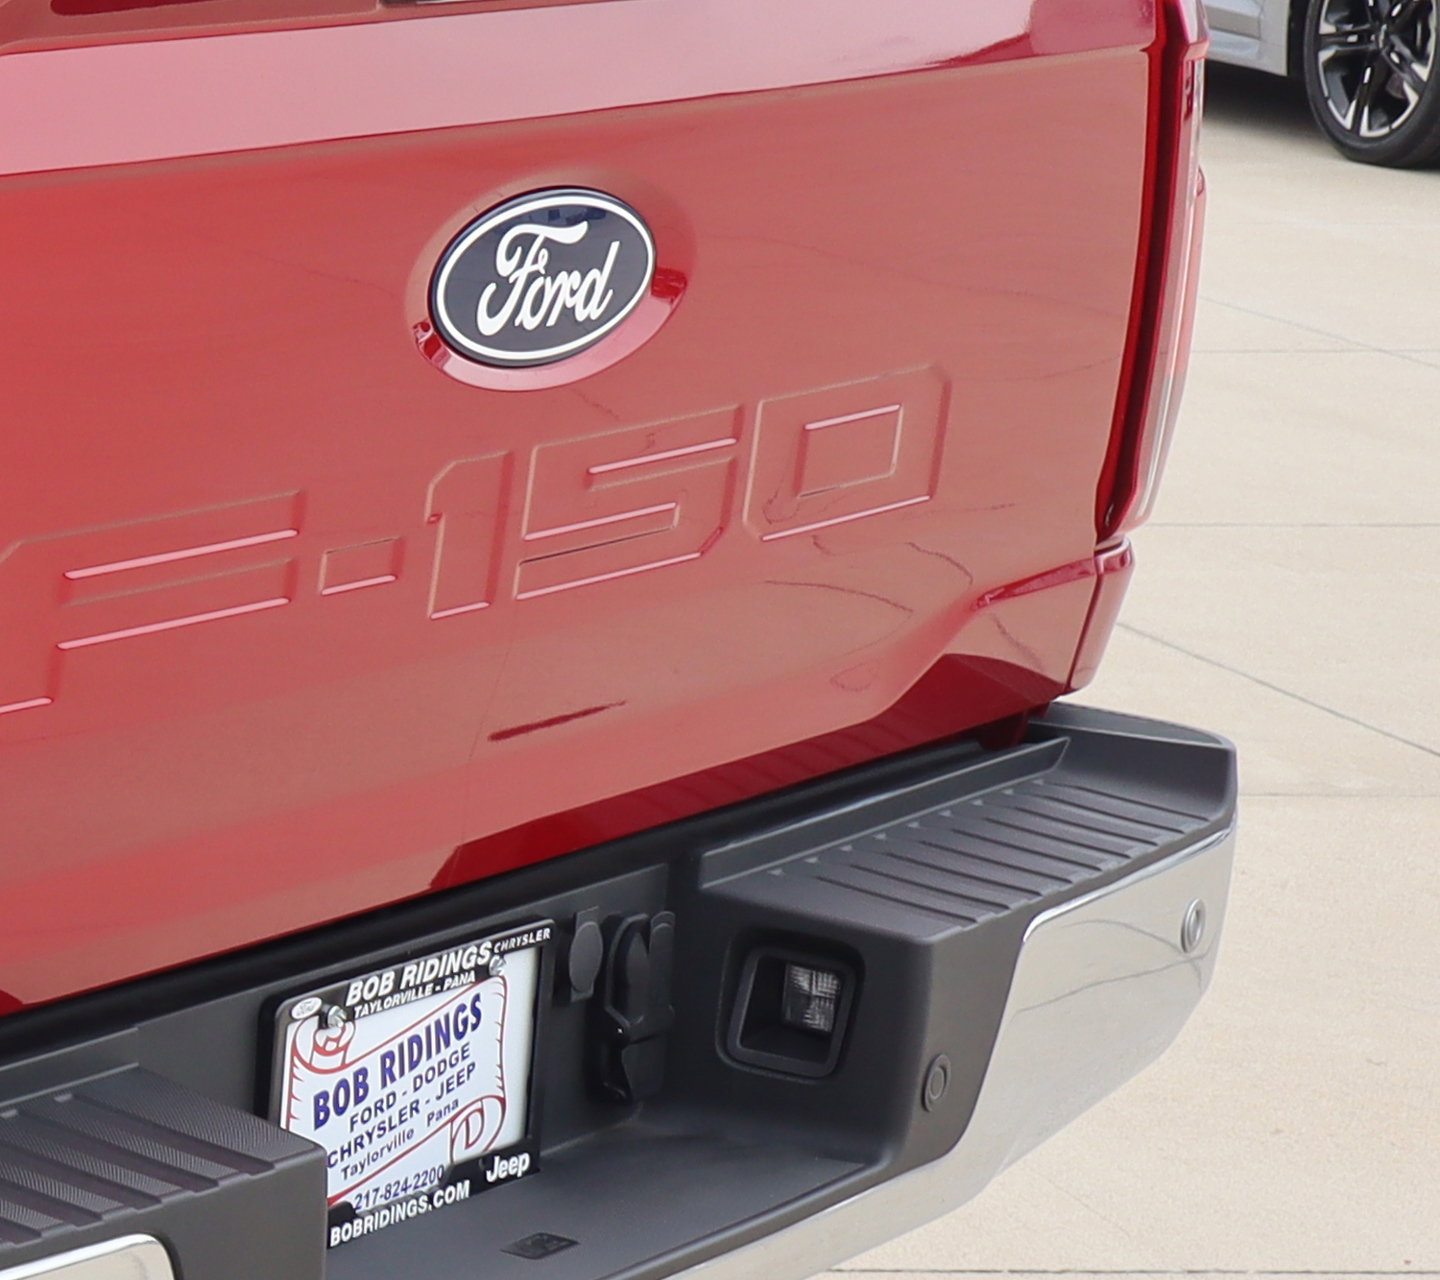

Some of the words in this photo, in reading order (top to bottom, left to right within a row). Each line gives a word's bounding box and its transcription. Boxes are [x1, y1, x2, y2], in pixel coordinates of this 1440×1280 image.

[477, 221, 621, 336] Ford
[345, 968, 396, 1007] BOB
[399, 940, 493, 990] RIDINGS
[493, 927, 551, 954] CHRYSLER
[353, 982, 434, 1019] TAYLORVILLE
[442, 969, 476, 993] PANA
[313, 1066, 370, 1131] BOB
[380, 992, 482, 1090] RIDINGS
[349, 1090, 397, 1133] FORD
[412, 1041, 471, 1094] DODGE
[326, 1098, 420, 1169] CHRYSLER
[435, 1061, 477, 1101] JEEP
[340, 1128, 415, 1180] Taylorville
[426, 1098, 460, 1127] Pana
[354, 1164, 446, 1211] 217-824-2200
[485, 1152, 531, 1183] Jeep
[330, 1179, 471, 1247] BOBRIDINGS.COM
